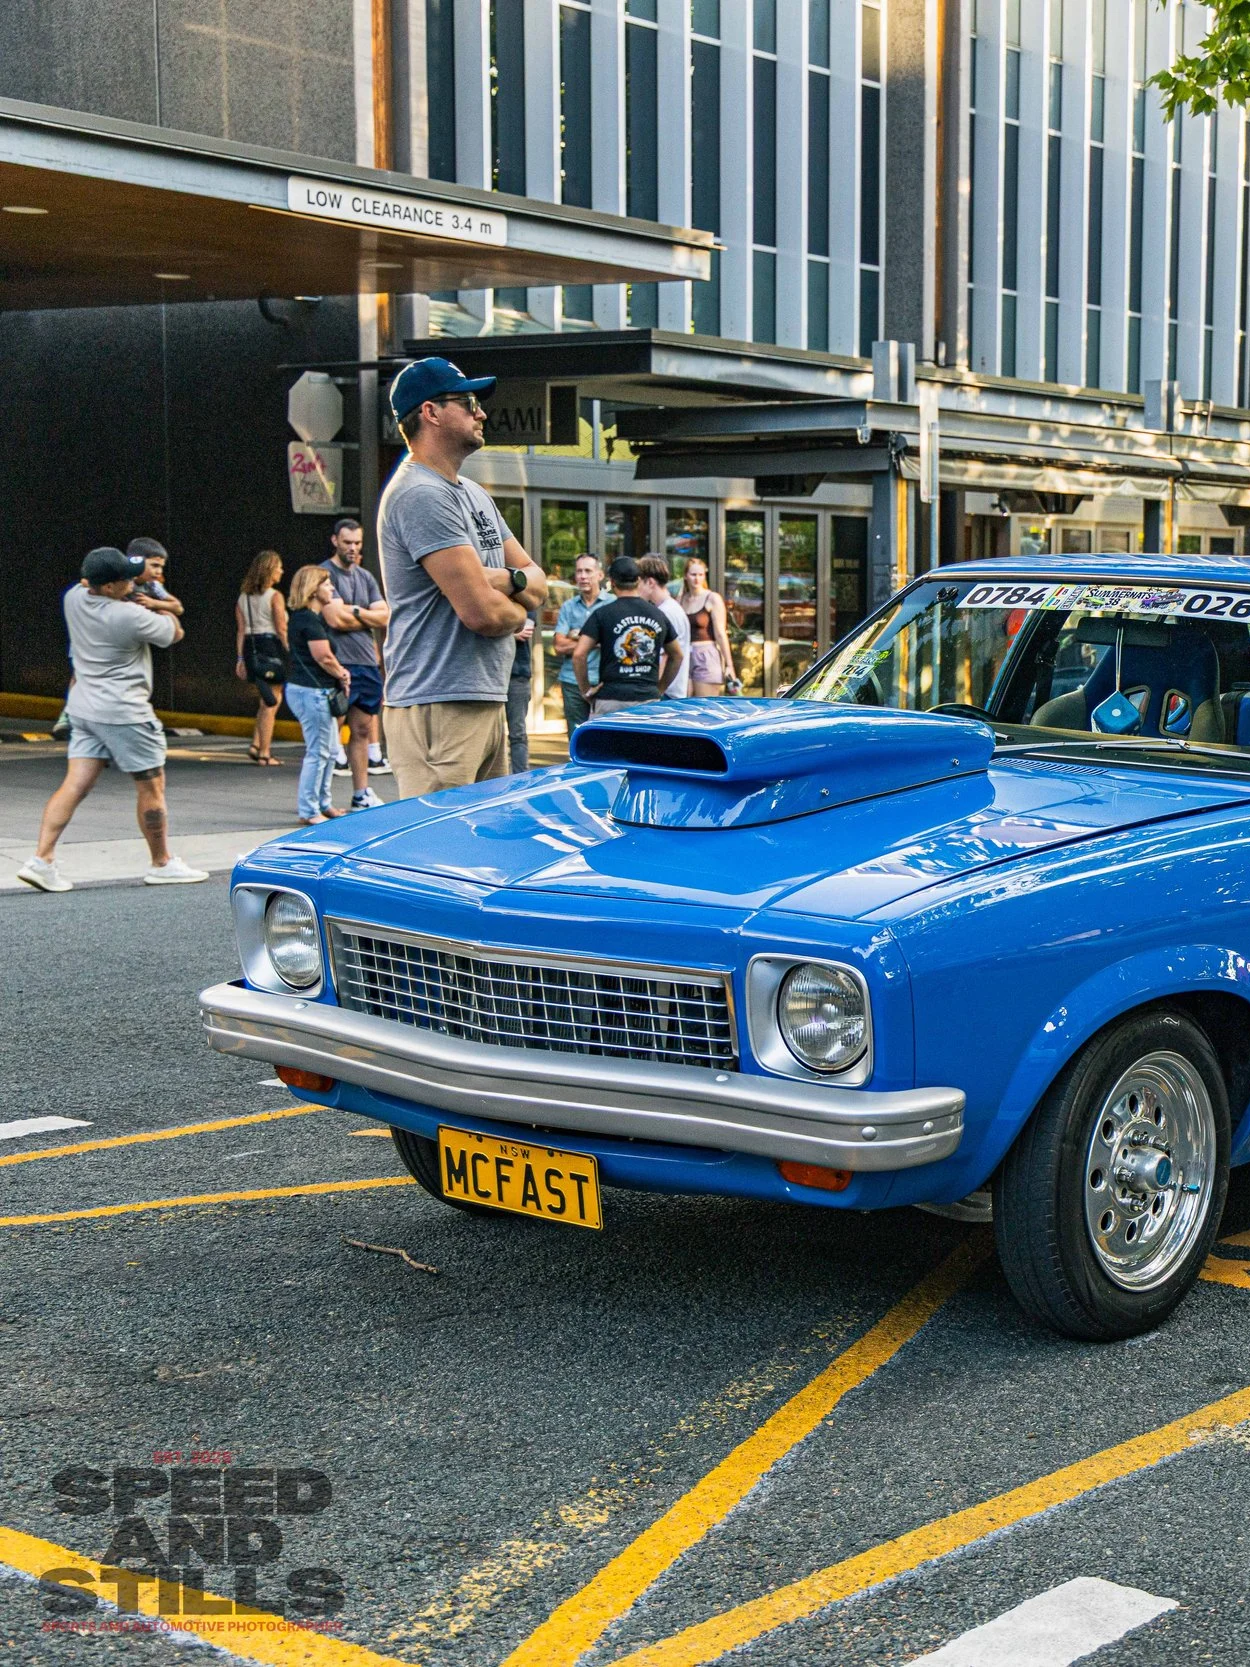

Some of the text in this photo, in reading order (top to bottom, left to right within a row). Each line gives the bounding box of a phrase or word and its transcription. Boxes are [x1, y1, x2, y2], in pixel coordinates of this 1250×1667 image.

[307, 189, 492, 234] LOW CLEARANCE 3.4 m
[966, 586, 1050, 606] 0784
[1086, 588, 1153, 601] SUMMERNATS
[1105, 598, 1121, 606] 38
[613, 615, 663, 635] CASTLEMAINE
[635, 665, 652, 674] SHOP
[500, 1144, 531, 1160] NSW
[445, 1146, 589, 1220] MCFAST
